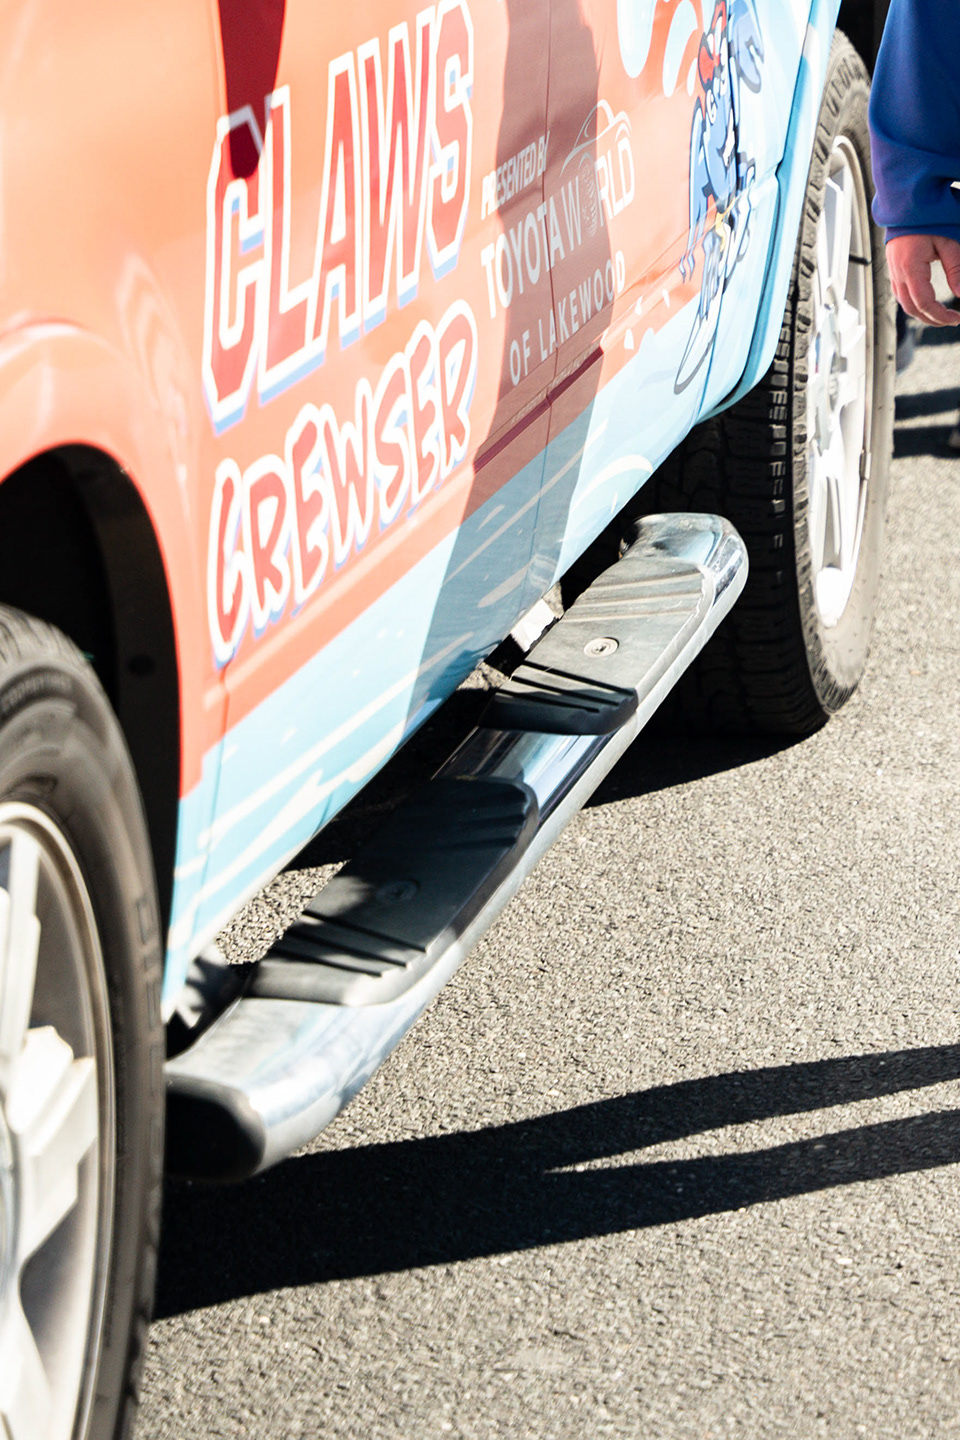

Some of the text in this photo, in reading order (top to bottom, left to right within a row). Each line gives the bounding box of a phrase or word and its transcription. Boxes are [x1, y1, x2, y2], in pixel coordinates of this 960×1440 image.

[481, 142, 537, 220] PRESENTED
[509, 250, 626, 386] OF LAKEWOOD
[207, 299, 479, 667] CREWSER
